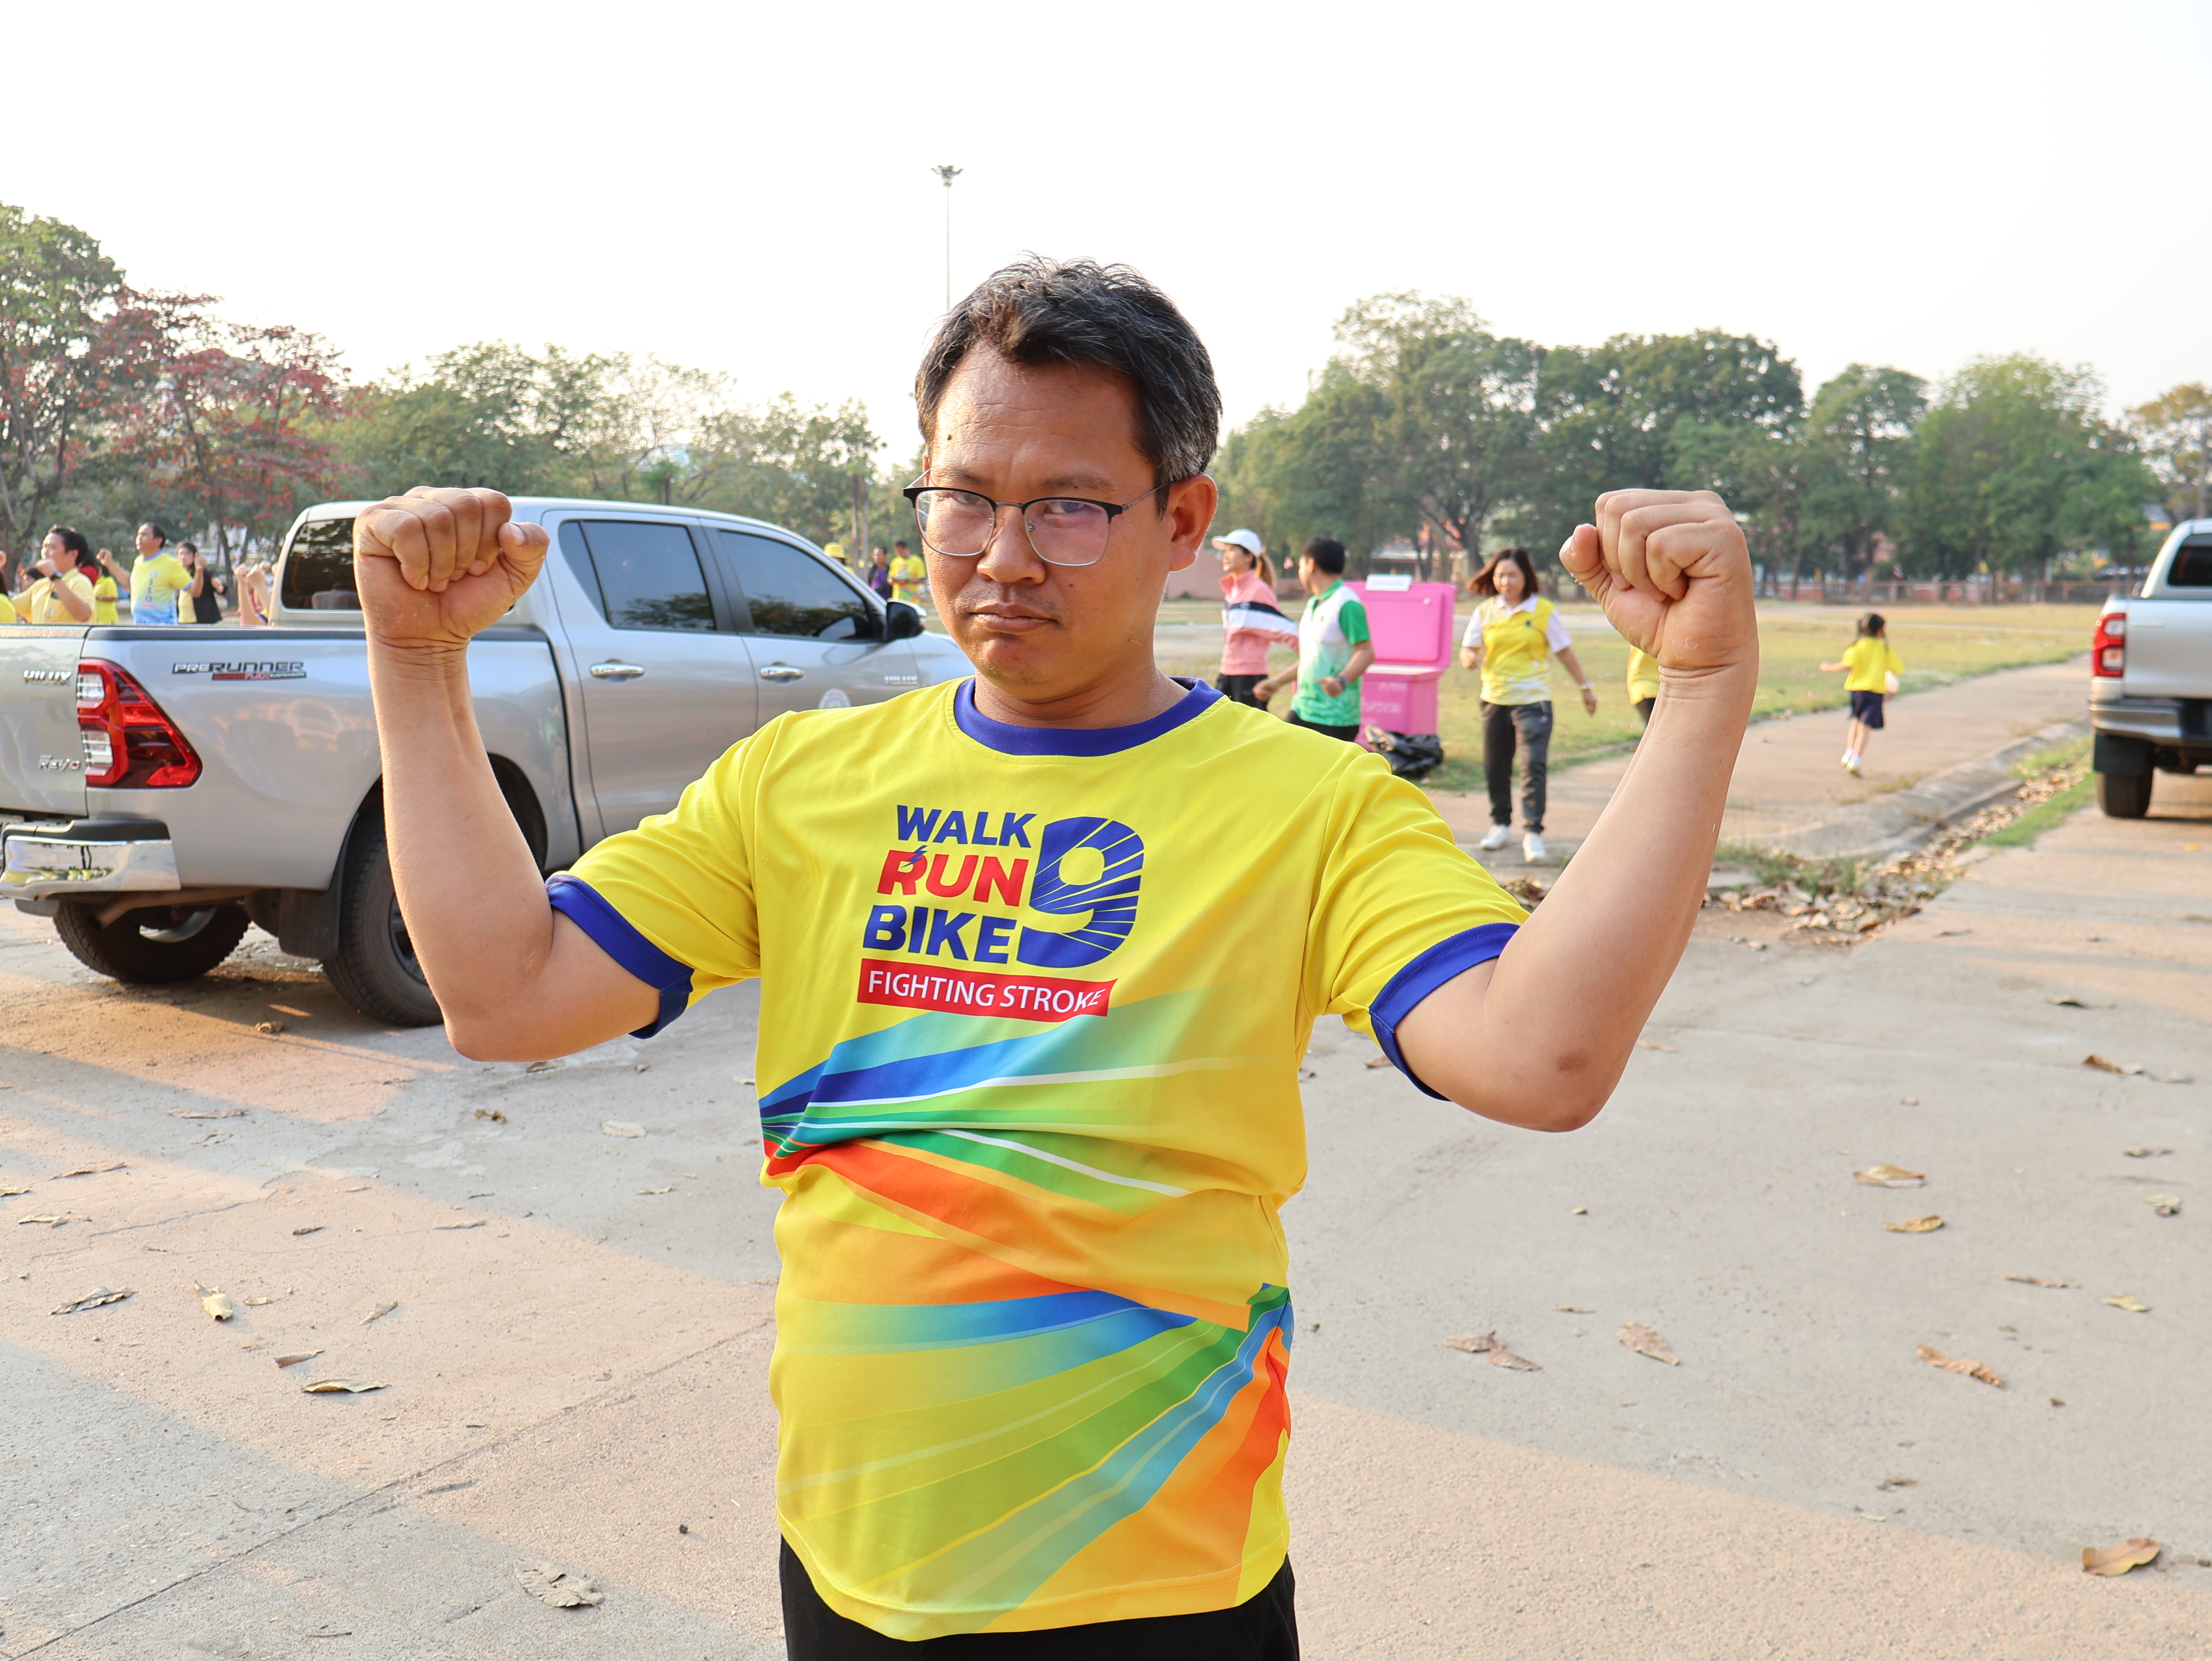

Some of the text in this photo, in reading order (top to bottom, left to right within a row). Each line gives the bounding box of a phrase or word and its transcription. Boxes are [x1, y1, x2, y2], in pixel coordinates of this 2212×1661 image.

[172, 662, 304, 674] PRERUNNER
[897, 805, 1037, 848] WALK
[877, 850, 1029, 907] RUN
[1016, 816, 1145, 968] 9
[863, 905, 1016, 964] BIKE
[869, 970, 1106, 1013] FIGHTING STROKE
